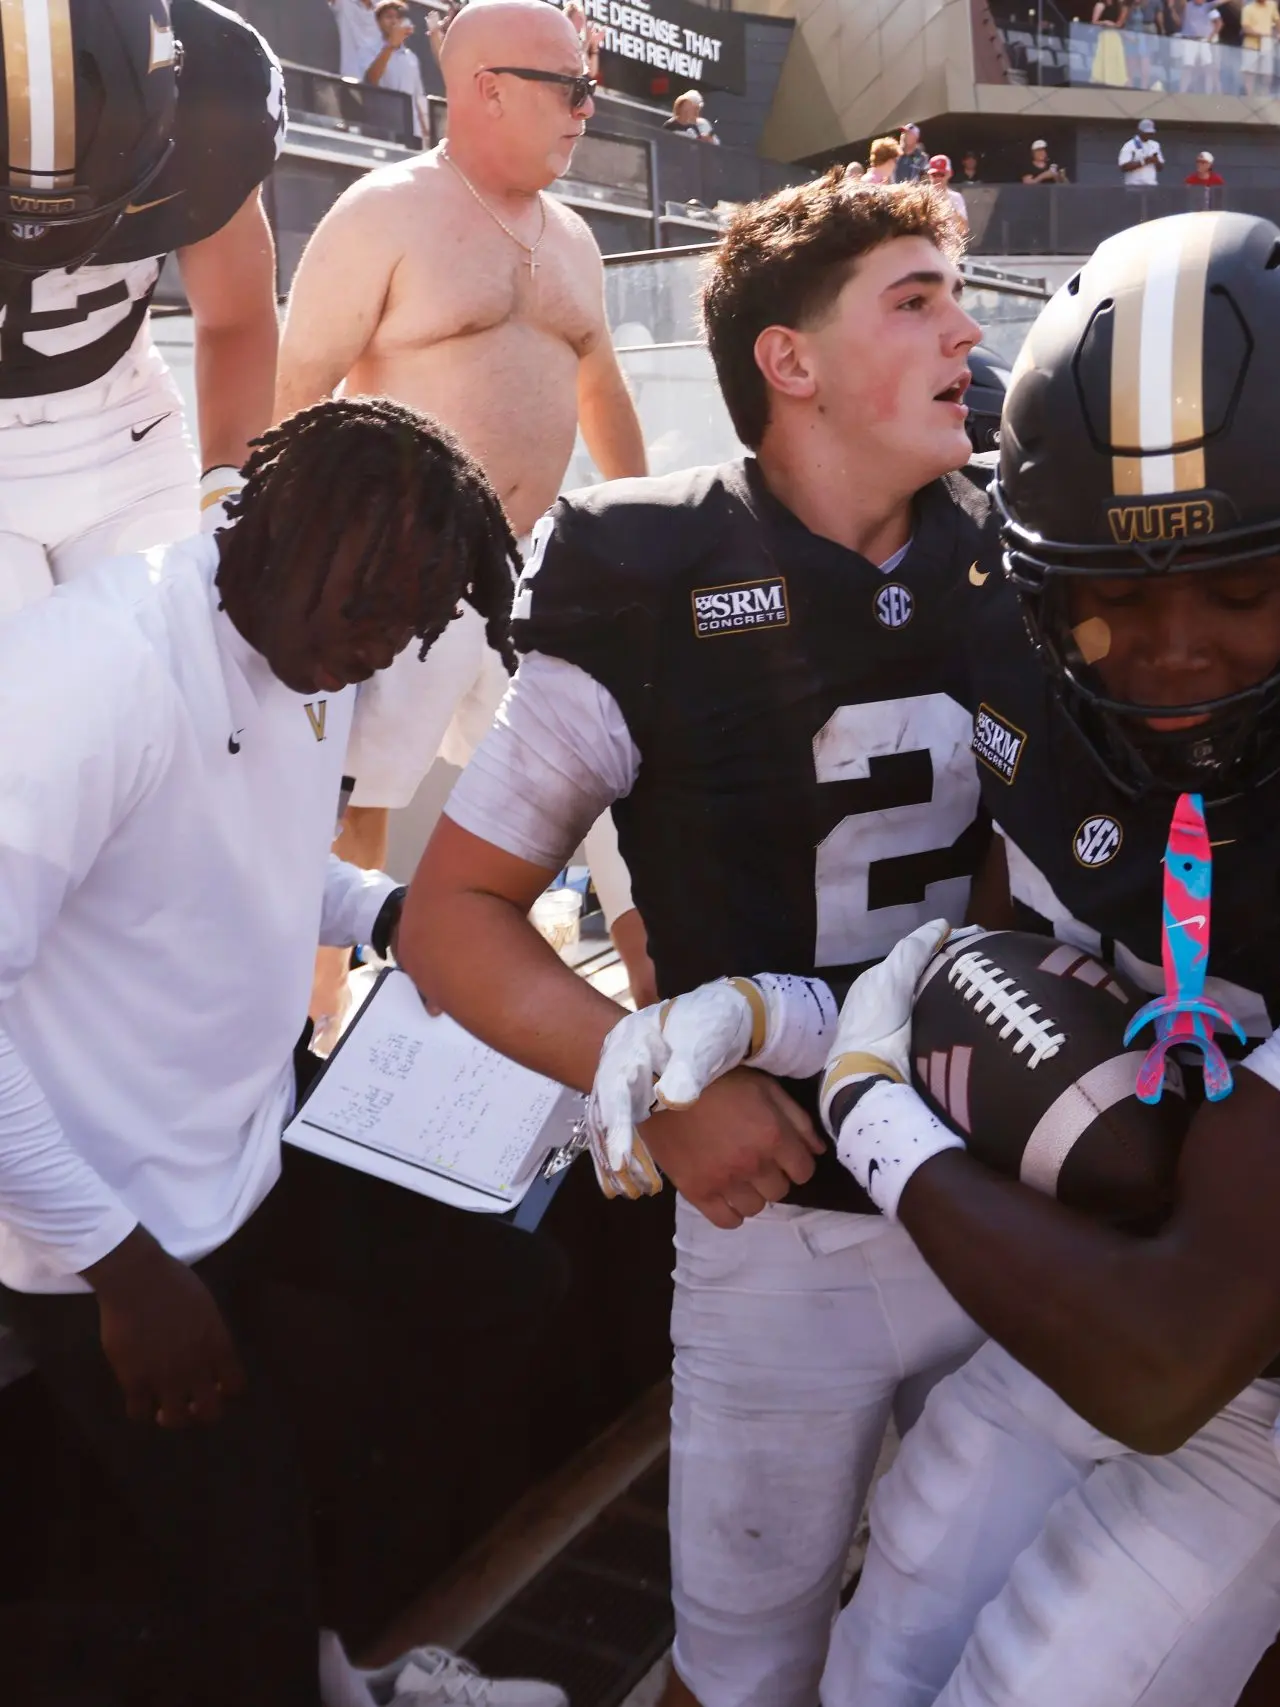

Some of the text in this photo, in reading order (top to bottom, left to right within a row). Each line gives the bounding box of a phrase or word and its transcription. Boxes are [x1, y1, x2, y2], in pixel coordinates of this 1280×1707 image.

[646, 42, 704, 80] REVIEW
[682, 28, 722, 62] THAT
[1108, 500, 1214, 544] VUFB
[698, 610, 787, 632] CONCRETE
[711, 585, 785, 619] SRM
[876, 586, 912, 627] SEC
[303, 699, 327, 742] V
[972, 736, 1014, 777] CONCRETE
[983, 718, 1021, 766] SRM
[813, 692, 981, 968] 2
[1076, 818, 1119, 865] SEC
